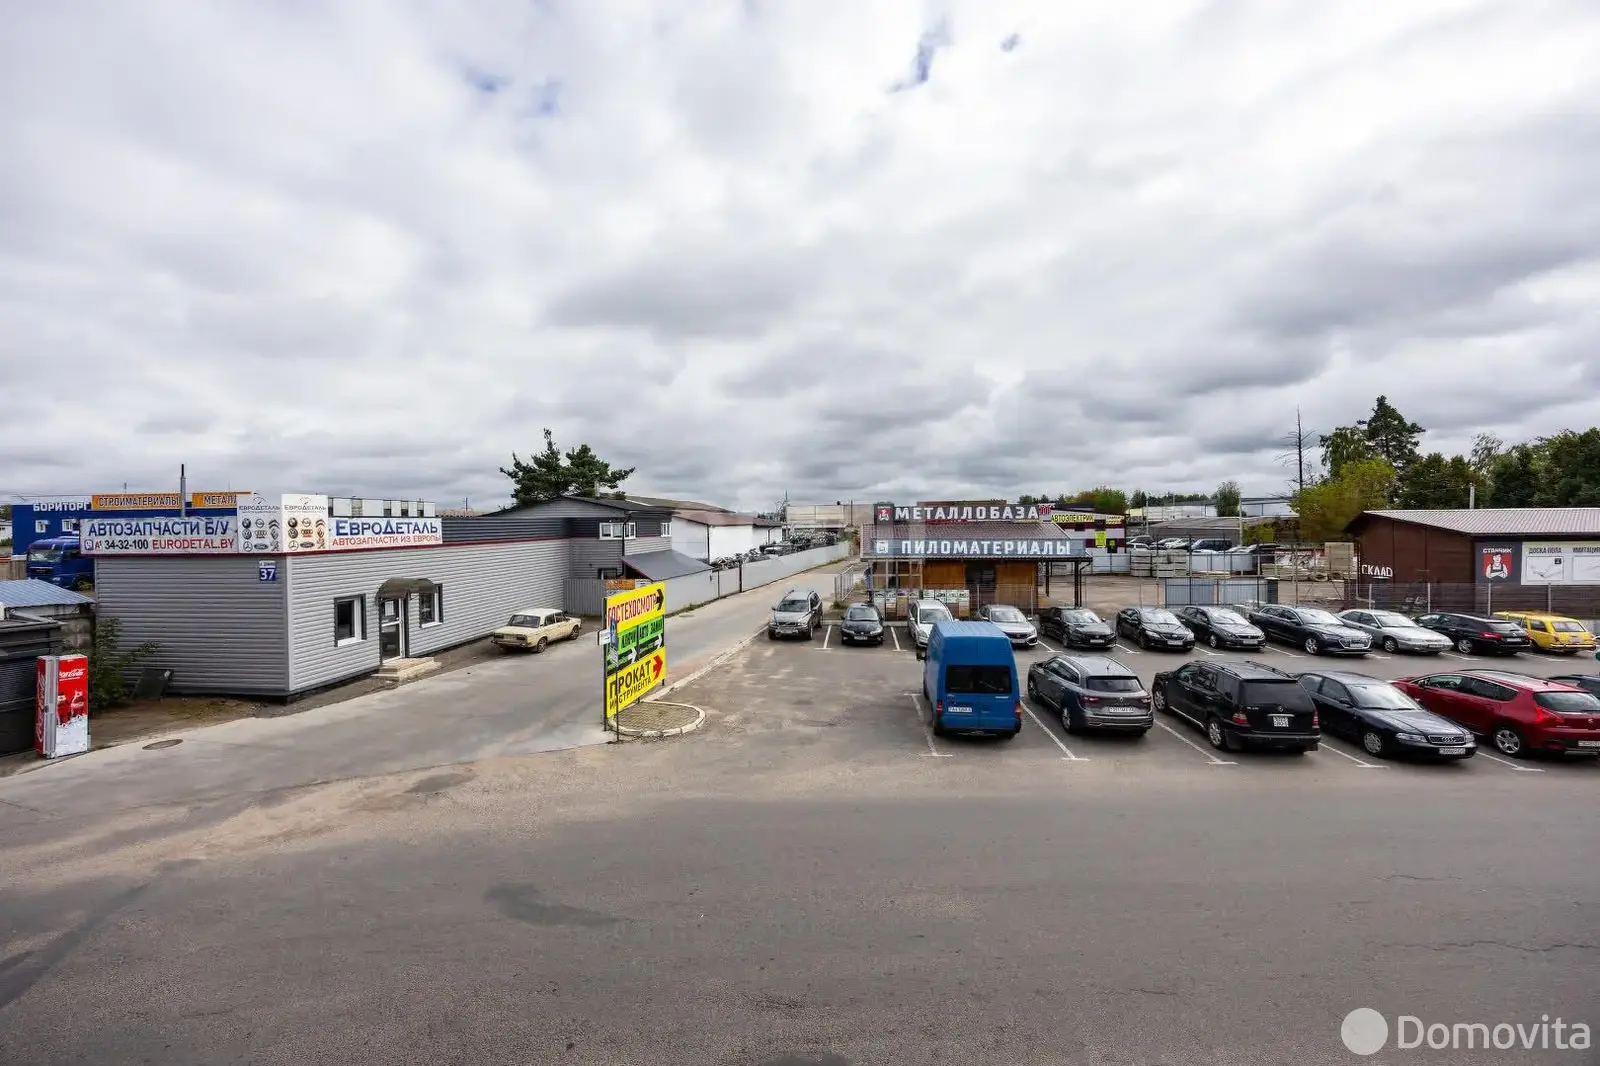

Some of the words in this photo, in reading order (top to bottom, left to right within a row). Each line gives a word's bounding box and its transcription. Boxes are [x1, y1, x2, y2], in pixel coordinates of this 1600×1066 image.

[894, 506, 1039, 519] МЕТАЛЛОБАЗА
[88, 522, 200, 536] АВТОЗАПЧАСТИ
[205, 520, 230, 535] Б/У
[105, 539, 148, 550] 34-32-100
[152, 538, 235, 549] EURODETAL.BY
[332, 536, 398, 546] АВТОЗАПЧАСТИ
[901, 540, 1071, 555] ПИЛОМАТЕРИАЛЫ
[260, 569, 275, 580] 37
[1361, 564, 1393, 577] СКЛАД
[610, 661, 651, 699] ПРОКАТ
